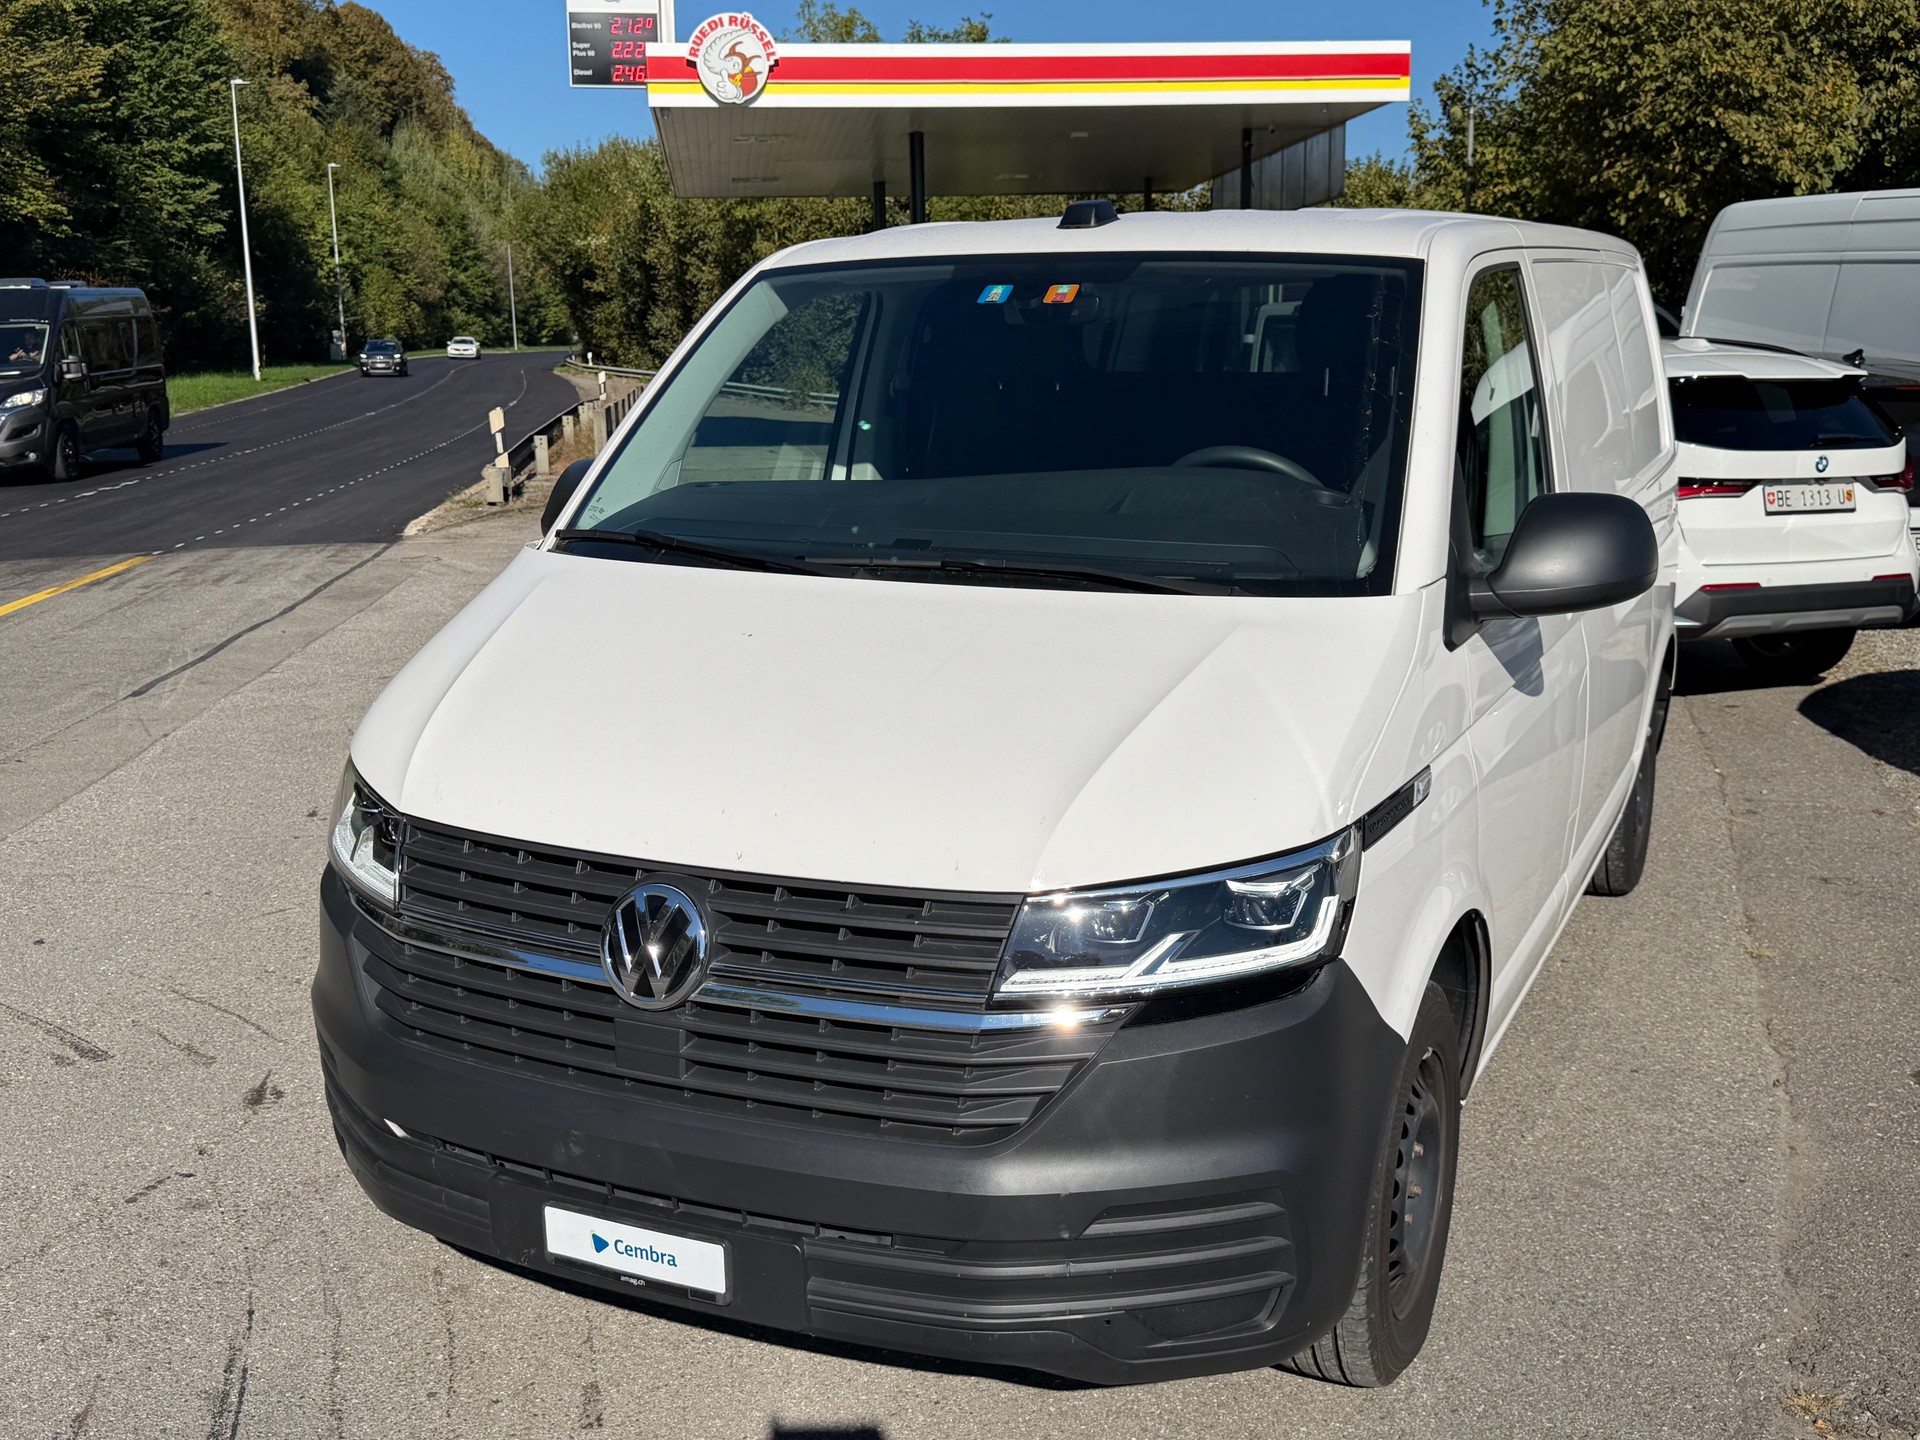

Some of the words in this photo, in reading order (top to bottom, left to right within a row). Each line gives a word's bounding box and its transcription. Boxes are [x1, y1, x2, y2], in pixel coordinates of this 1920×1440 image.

[572, 41, 591, 50] Super
[688, 17, 724, 58] RUEDI
[728, 14, 776, 61] RÜSSEL
[572, 49, 587, 57] Plus
[1776, 490, 1792, 507] BE
[1801, 489, 1832, 507] 1313
[613, 1238, 678, 1268] Cembra
